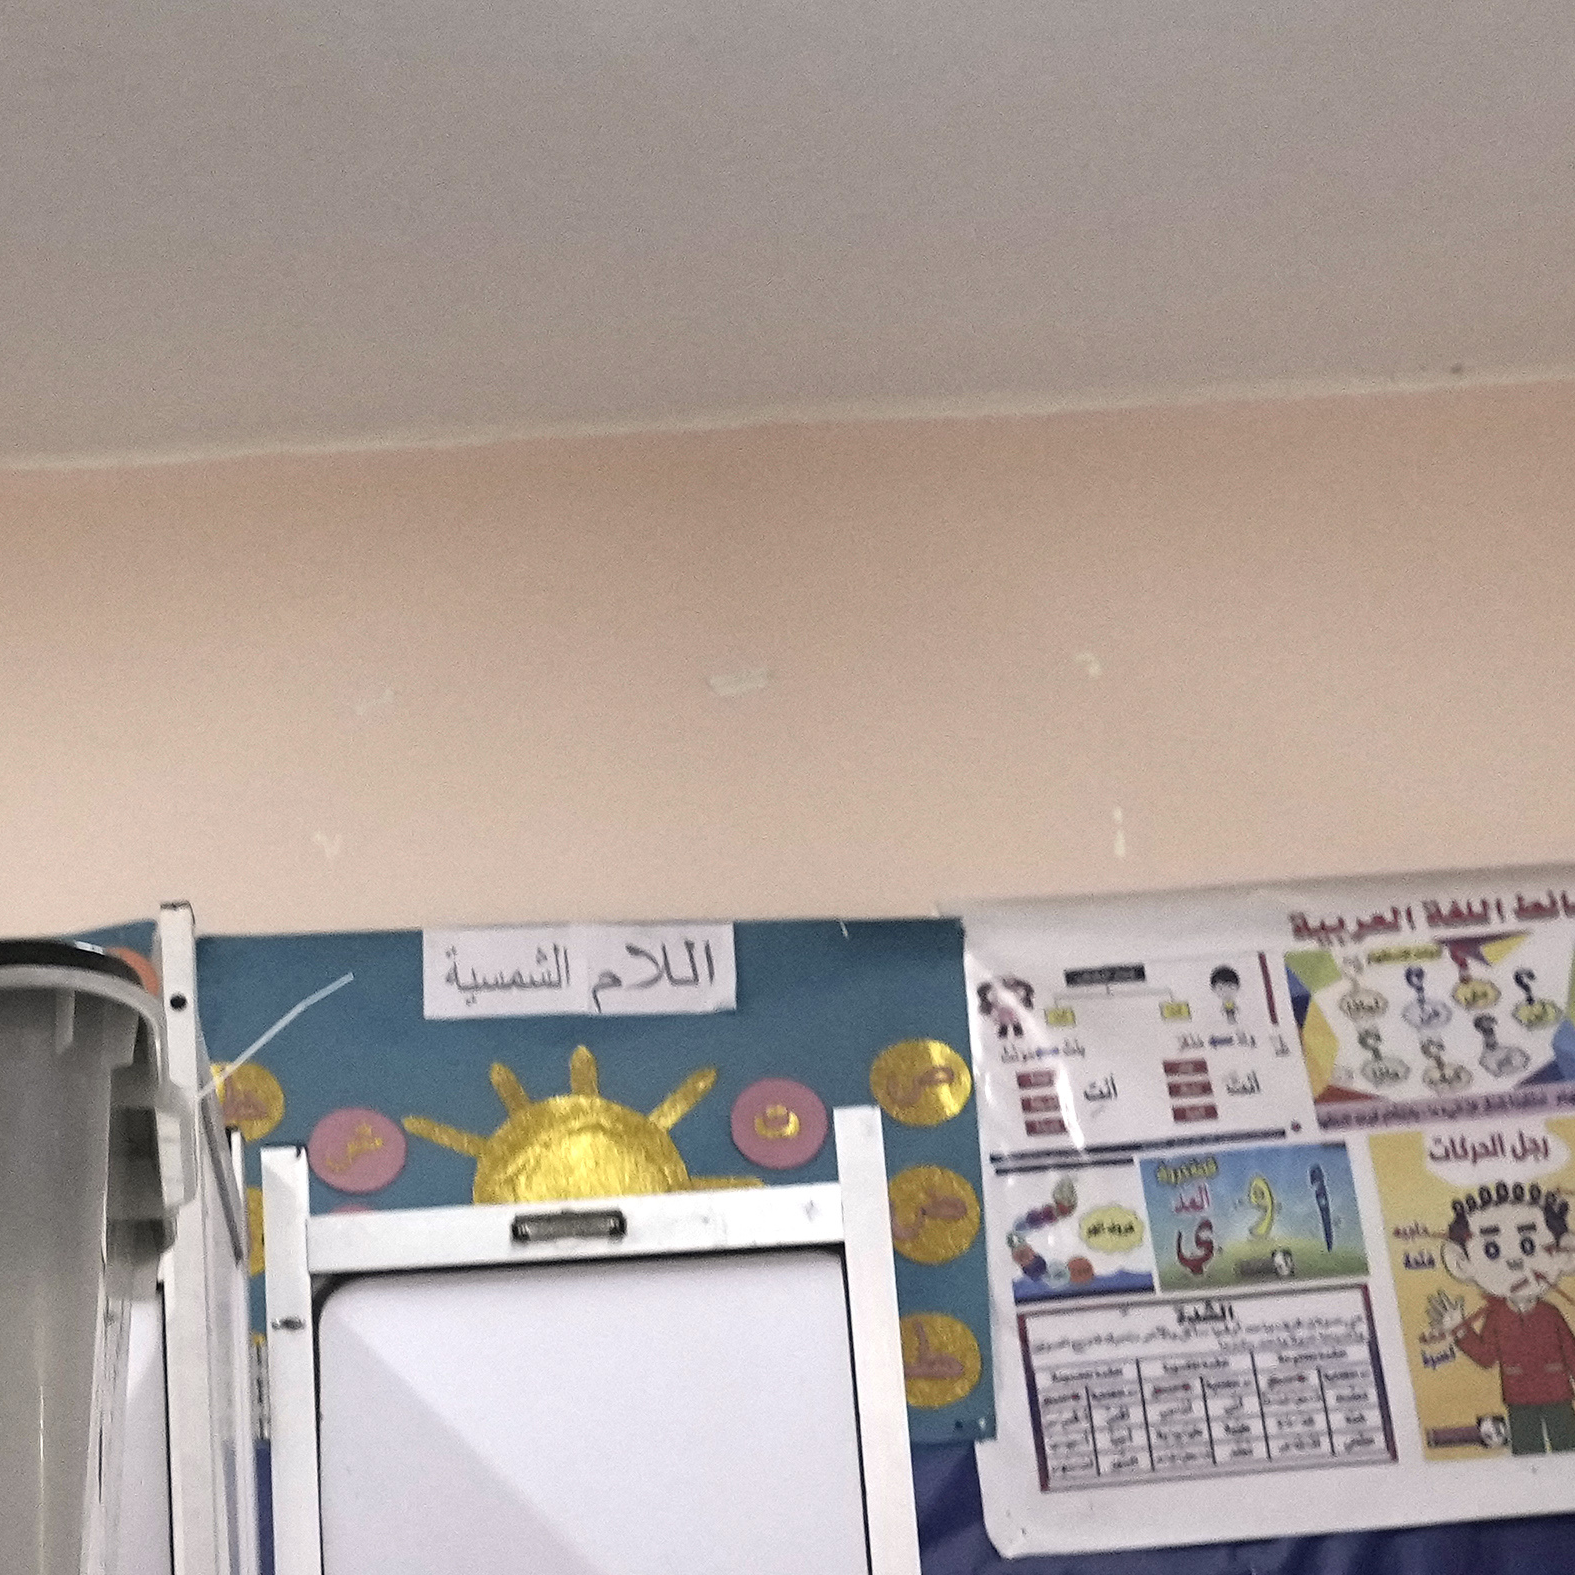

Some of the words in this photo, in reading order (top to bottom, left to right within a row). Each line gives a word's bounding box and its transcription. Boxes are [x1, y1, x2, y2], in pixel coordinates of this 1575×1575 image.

[1422, 897, 1505, 929] اللغة
[1512, 889, 1575, 922] ائط
[1288, 904, 1416, 947] العربية
[444, 942, 571, 1007] الشمسية
[587, 938, 716, 1014] اللام
[1429, 1131, 1507, 1167] الحركات
[1511, 1127, 1550, 1164] رجل
